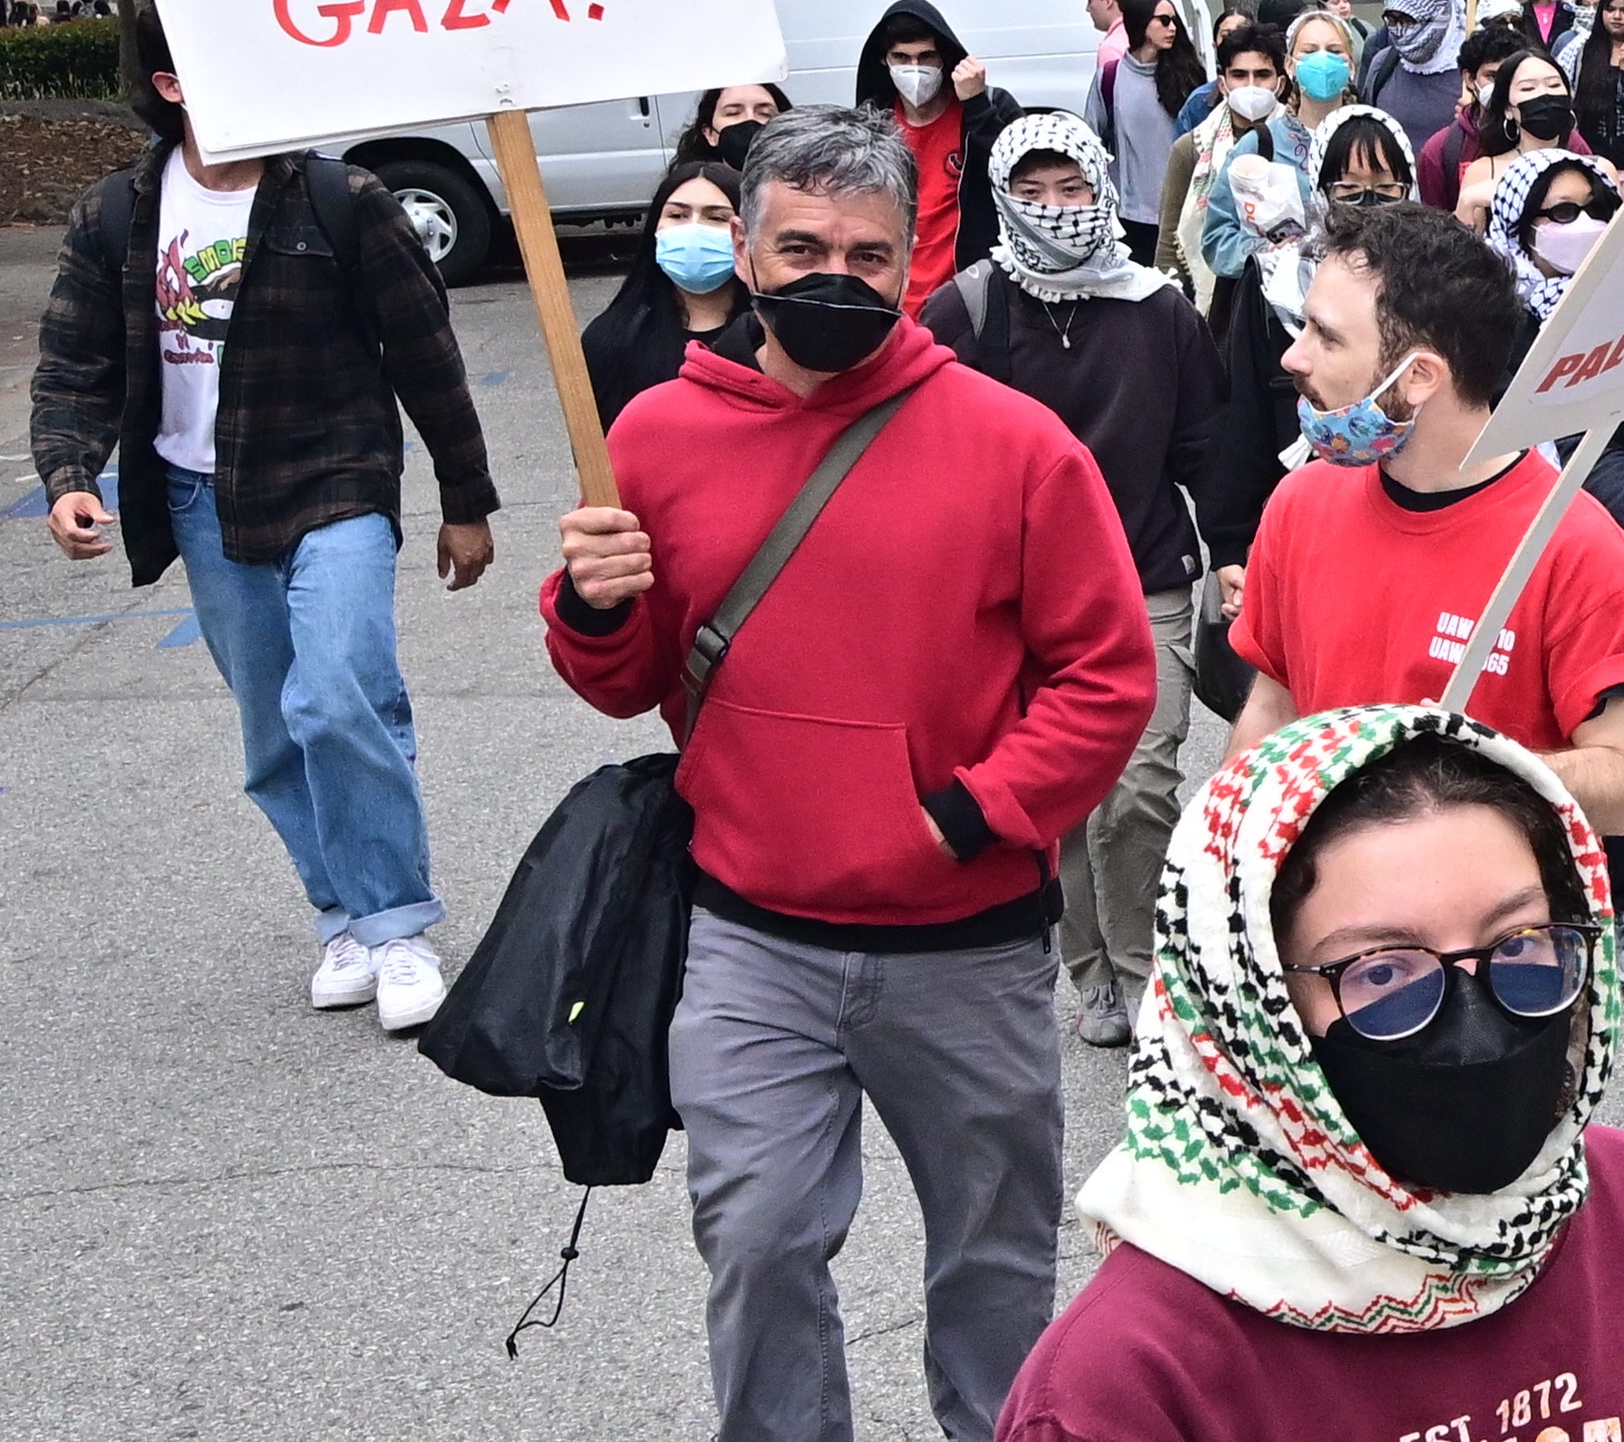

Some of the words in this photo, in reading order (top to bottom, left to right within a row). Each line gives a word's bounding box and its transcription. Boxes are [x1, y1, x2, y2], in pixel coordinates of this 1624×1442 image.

[1436, 611, 1475, 640] UAW
[1497, 628, 1516, 652] 10
[1428, 635, 1466, 664] UAW
[1481, 652, 1510, 676] 65
[1495, 1371, 1583, 1435] 1872
